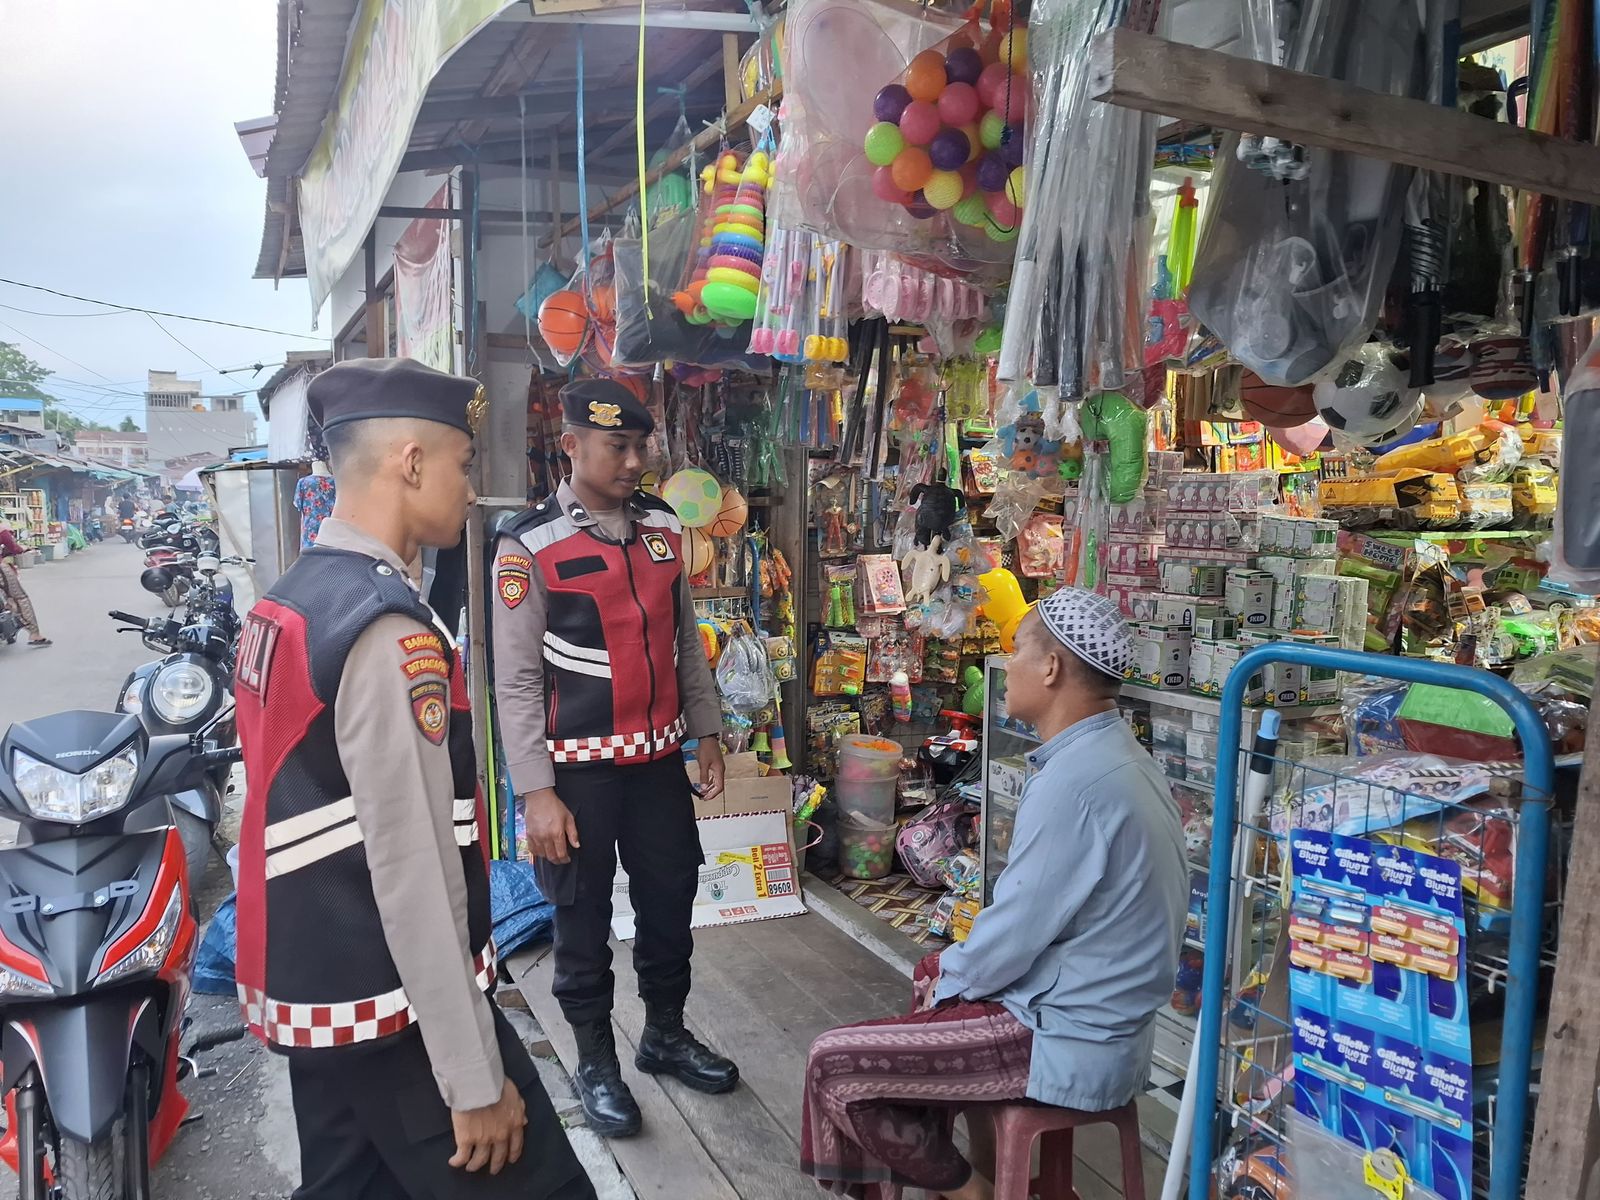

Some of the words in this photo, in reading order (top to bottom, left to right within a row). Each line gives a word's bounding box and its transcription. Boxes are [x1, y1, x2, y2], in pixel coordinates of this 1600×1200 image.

[1364, 540, 1401, 556] Sweet
[1363, 549, 1394, 562] Home
[1248, 614, 1265, 623] SKEM
[404, 636, 443, 650] BAHARKA
[1166, 674, 1183, 684] SKEM
[56, 750, 101, 759] HONDA
[1294, 840, 1328, 854] Gillette
[751, 848, 759, 862] Beli
[1299, 850, 1318, 861] Blue
[1334, 848, 1371, 863] Gillette
[754, 864, 762, 873] 2
[1339, 858, 1361, 871] Blue
[1376, 856, 1415, 874] Gillette
[754, 872, 762, 890] Extra
[1420, 867, 1456, 885] Gillette
[768, 882, 792, 895] 89608
[1424, 879, 1447, 892] Blue
[1380, 908, 1407, 921] Gillette
[1423, 920, 1449, 934] Gillette
[1378, 936, 1404, 948] Gillette
[1336, 953, 1363, 964] Gillette
[1294, 1017, 1327, 1036] Gillette
[1298, 1028, 1317, 1042] Blue
[1332, 1032, 1370, 1052] Gillette
[1338, 1045, 1359, 1058] Blue
[1377, 1048, 1417, 1069] Gillette
[1382, 1060, 1405, 1075] Blue
[1425, 1064, 1467, 1088] Gillette
[1431, 1077, 1454, 1093] Blue
